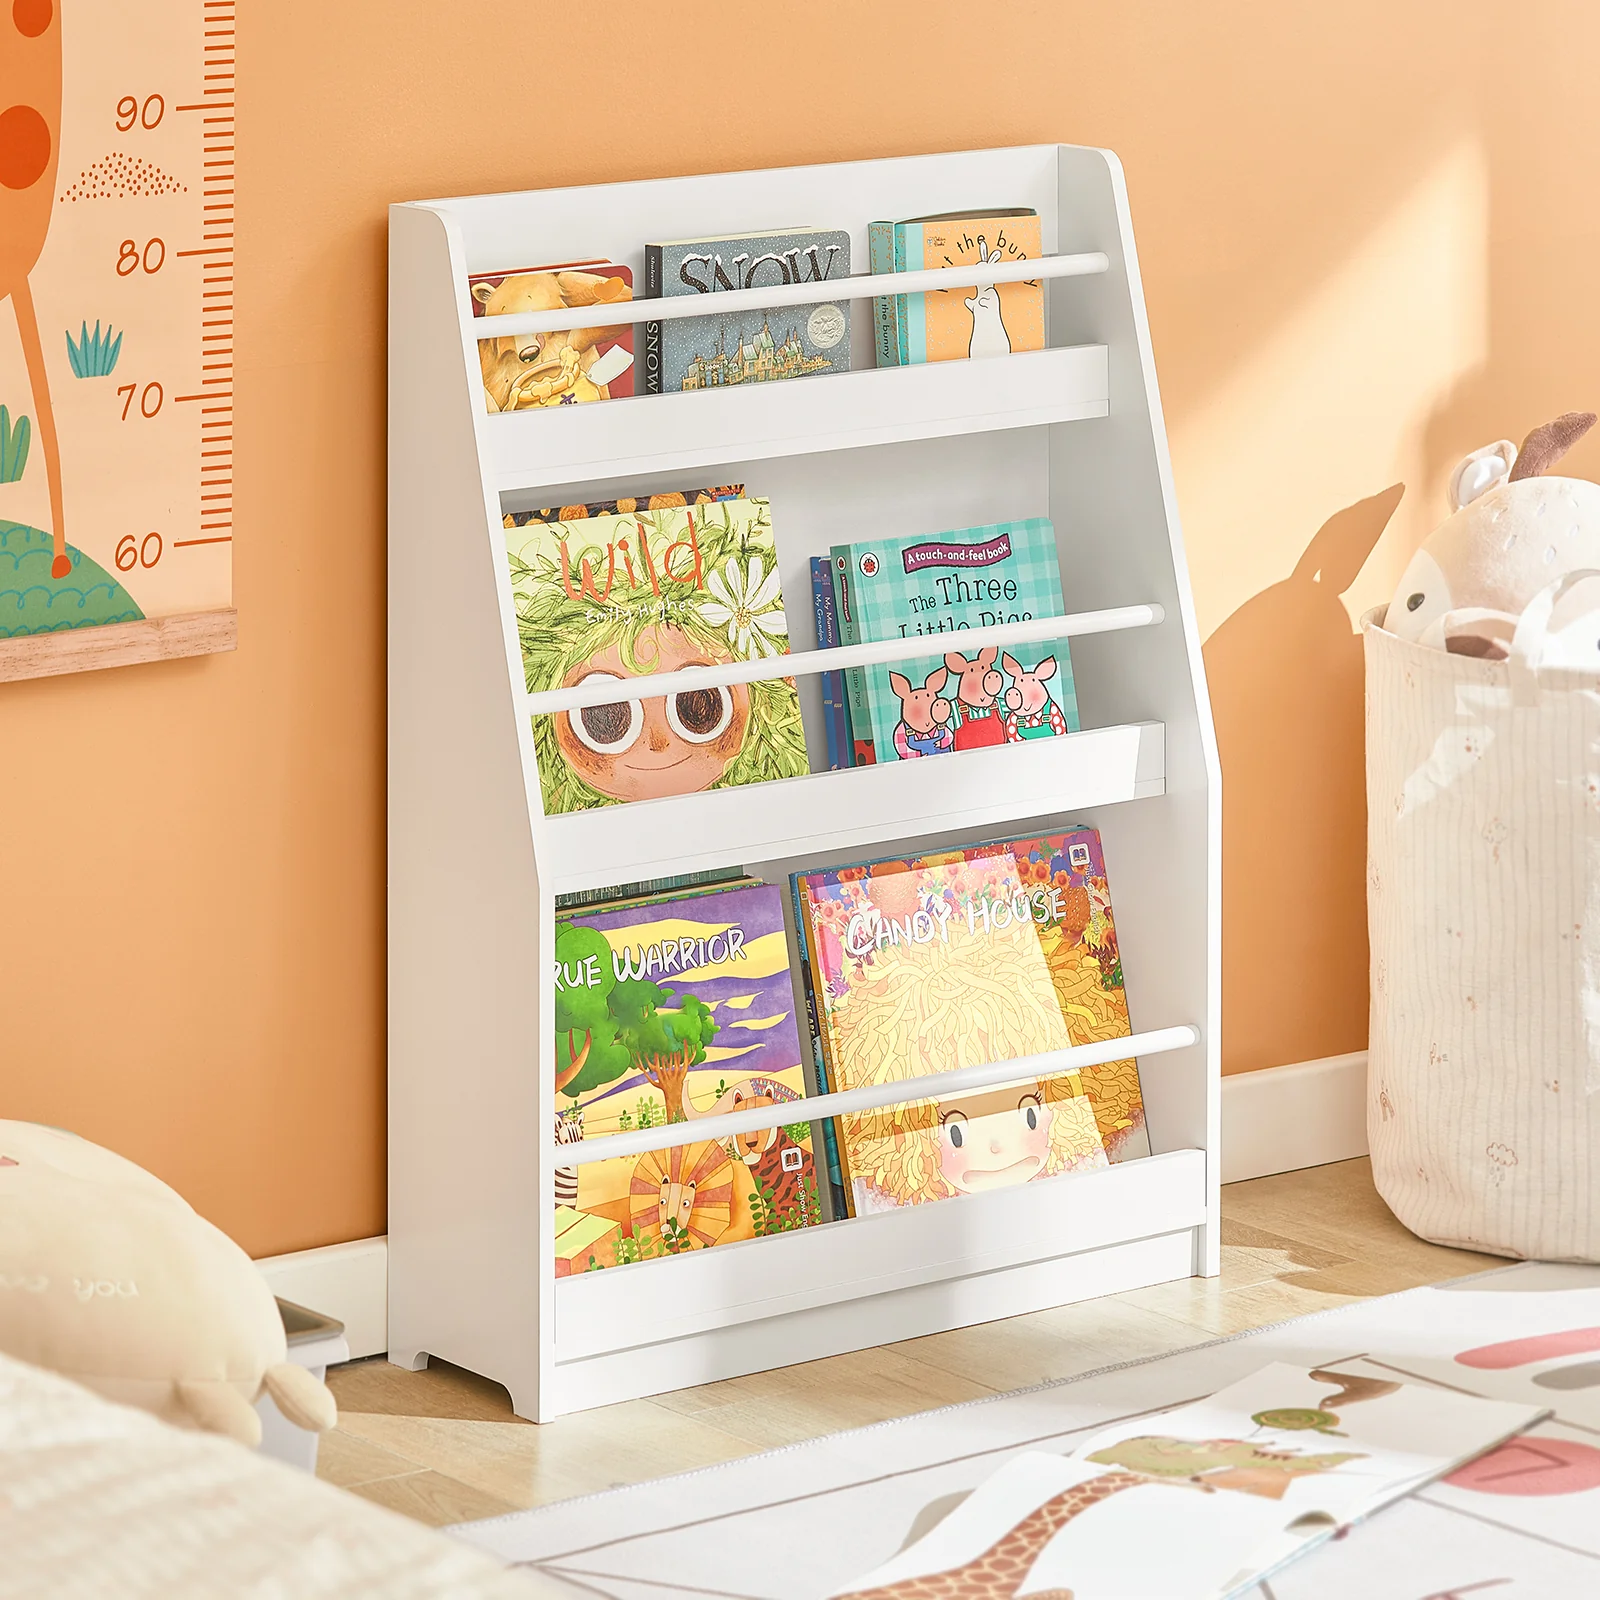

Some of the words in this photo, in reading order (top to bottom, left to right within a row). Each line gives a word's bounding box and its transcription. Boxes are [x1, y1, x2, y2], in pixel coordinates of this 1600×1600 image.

[115, 93, 165, 132] 90
[116, 237, 166, 277] 80
[680, 244, 841, 293] SNOW
[957, 234, 985, 253] the
[997, 230, 1037, 287] buny
[881, 304, 889, 321] the
[646, 321, 659, 393] SNOW
[882, 325, 890, 358] bunny
[117, 381, 164, 421] 70
[114, 532, 163, 572] 60
[908, 553, 915, 564] A
[988, 542, 1009, 559] book
[586, 606, 632, 625] Emily
[638, 595, 694, 621] Hughes
[815, 593, 821, 607] My
[824, 596, 831, 610] My
[909, 595, 937, 613] The
[935, 573, 1017, 605] Three
[847, 903, 952, 956] CANDY
[967, 887, 1067, 936] HOUSE
[611, 928, 747, 983] WARRIOR
[796, 1172, 804, 1188] Just
[73, 1277, 140, 1303] you
